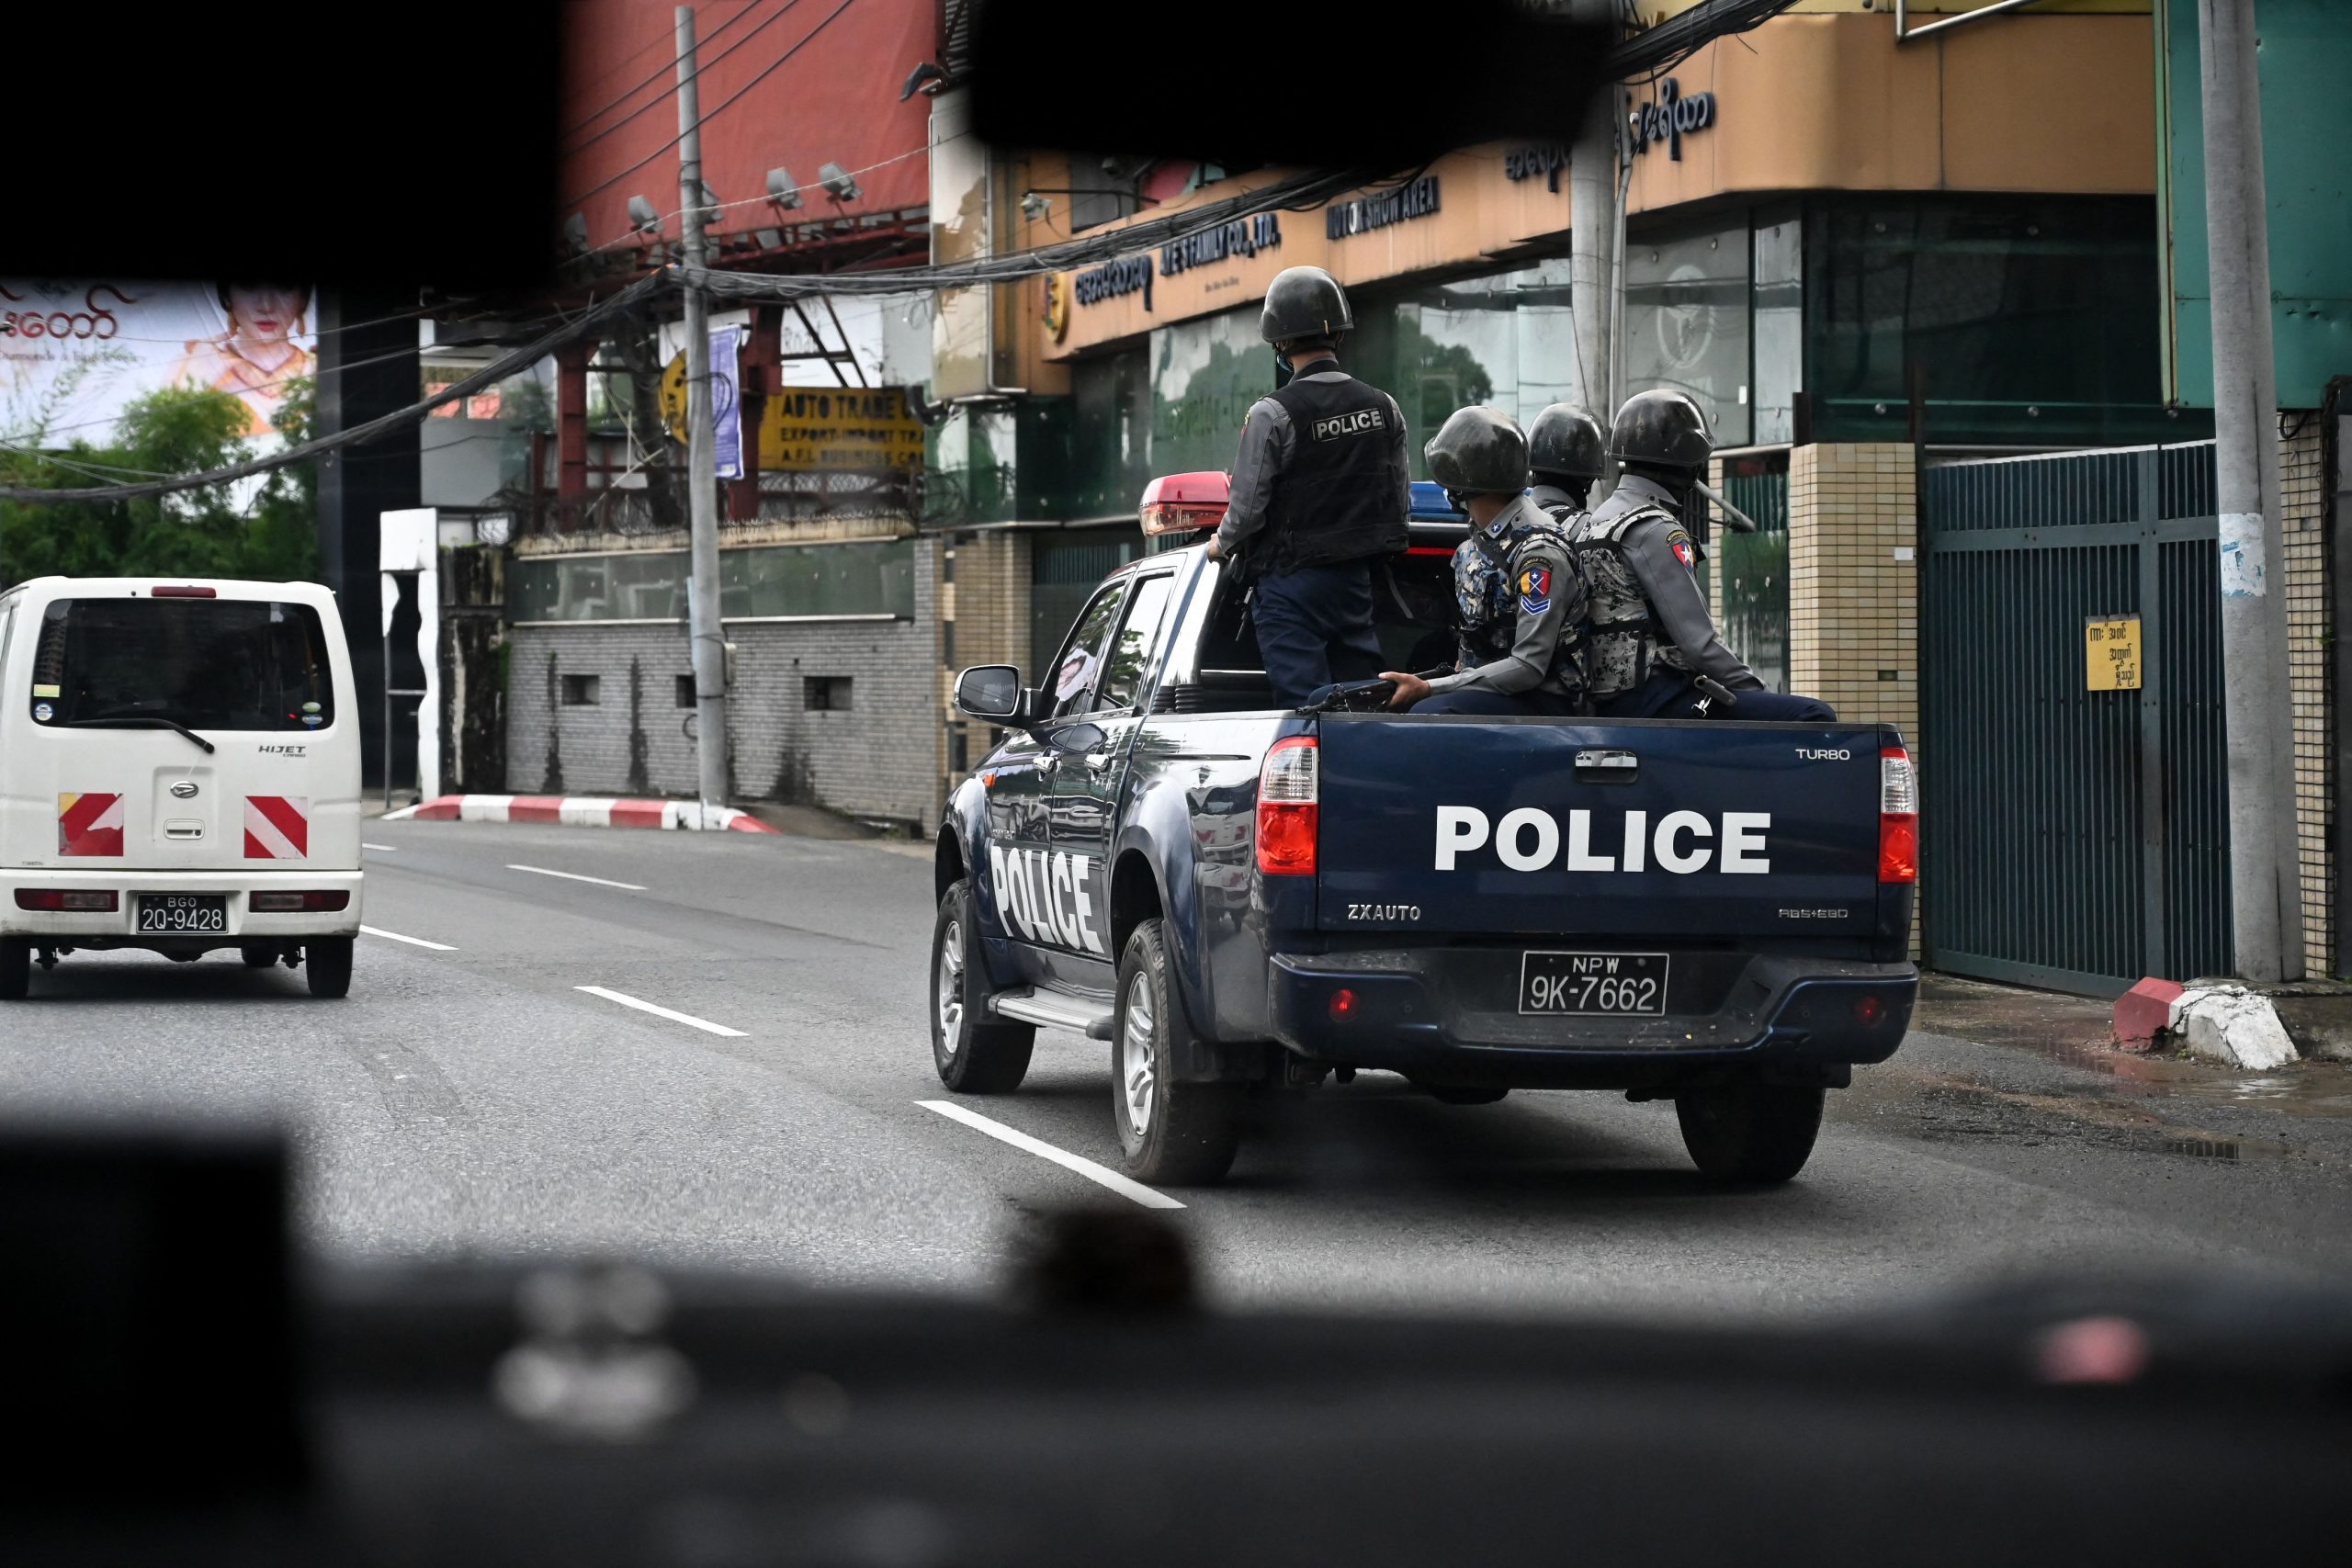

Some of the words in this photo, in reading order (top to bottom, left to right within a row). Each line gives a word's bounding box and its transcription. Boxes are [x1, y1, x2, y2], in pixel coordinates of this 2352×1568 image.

[1402, 175, 1442, 218] AREA
[783, 394, 830, 419] AUTO
[1317, 411, 1382, 438] POLICE
[258, 745, 306, 753] HIJET
[1795, 748, 1850, 761] TURBO
[1435, 805, 1771, 874] POLICE
[168, 897, 197, 908] BGO
[990, 845, 1105, 954] POLICE
[142, 908, 222, 930] 2Q-9428
[1348, 904, 1421, 921] ZXAUTO
[1779, 908, 1849, 919] ABS+EBD
[1572, 957, 1620, 975] NPW
[1530, 976, 1657, 1011] 9K-7662
